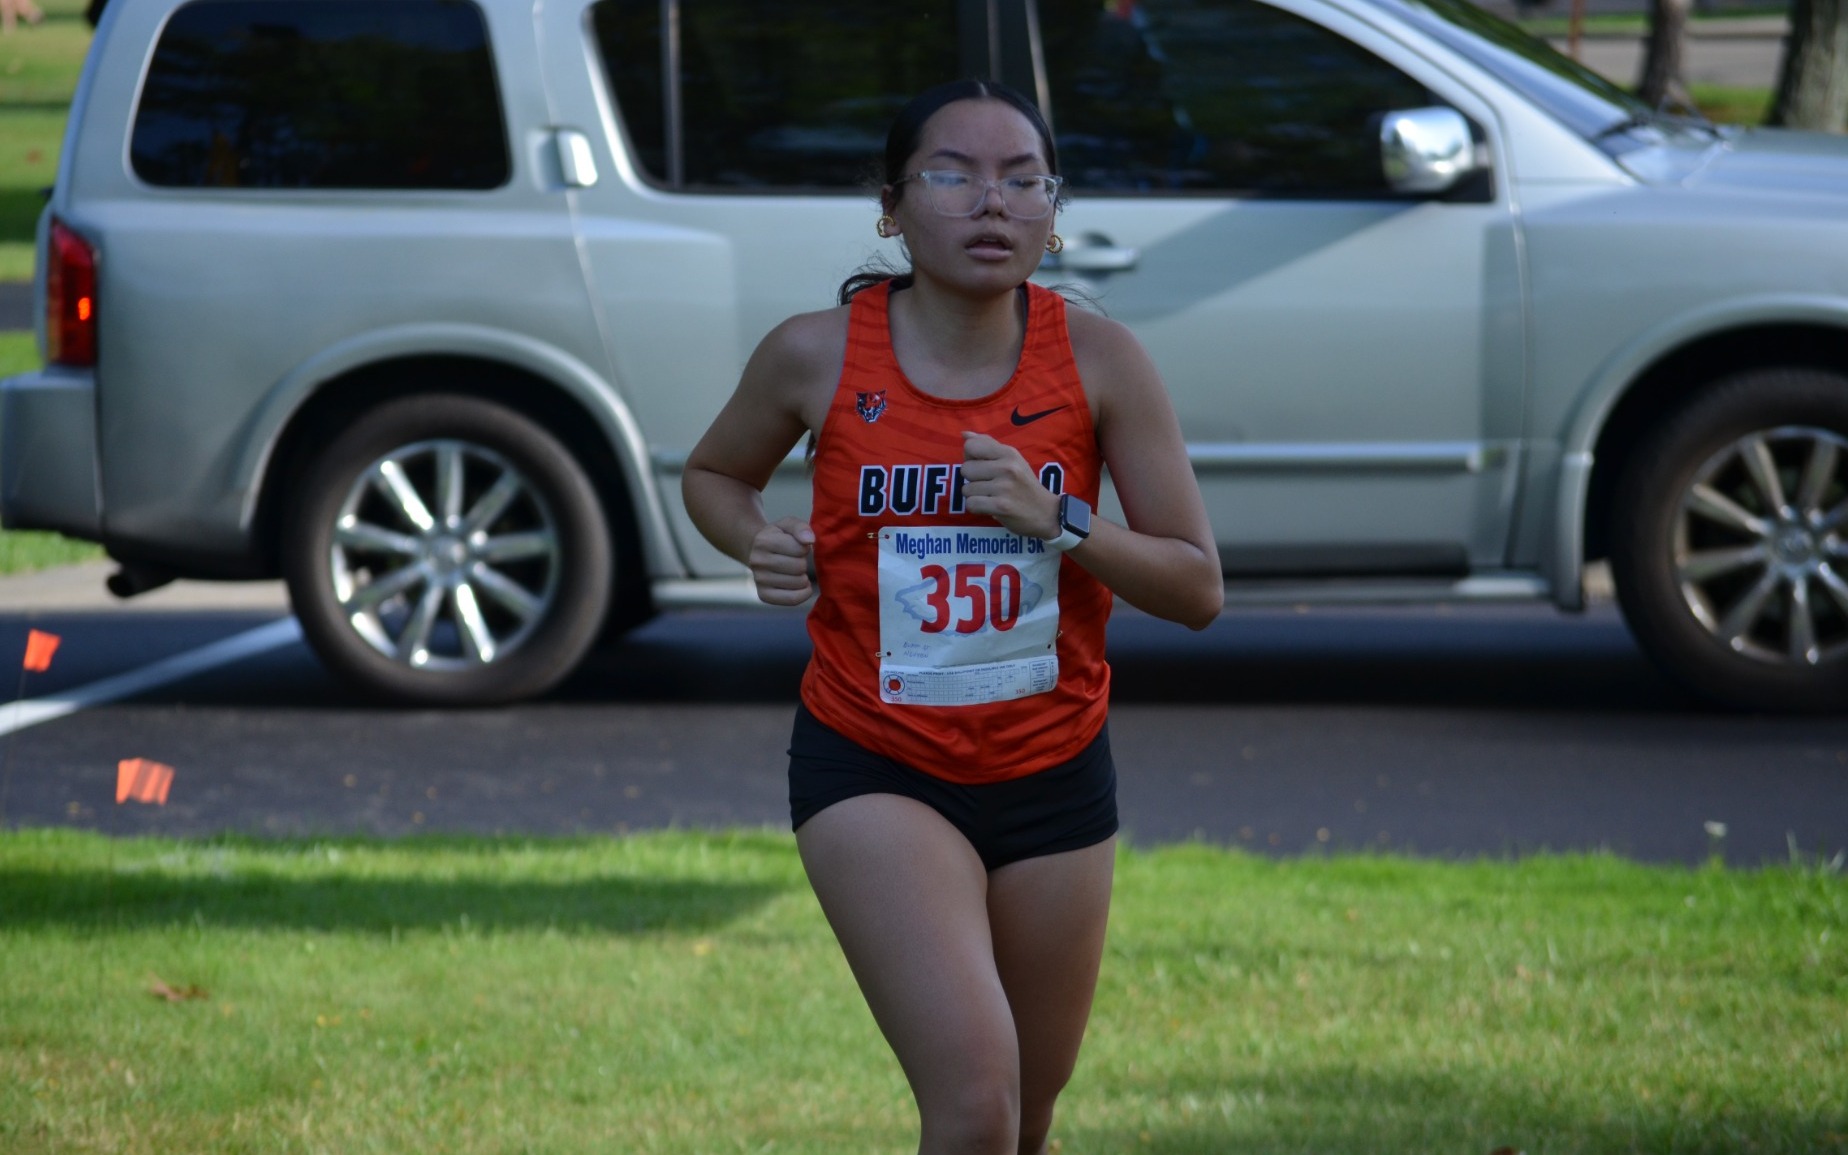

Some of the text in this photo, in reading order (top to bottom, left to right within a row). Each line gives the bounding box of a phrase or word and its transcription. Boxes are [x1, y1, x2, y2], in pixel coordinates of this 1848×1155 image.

[896, 533, 951, 560] Meghan
[956, 533, 1023, 554] Memorial
[920, 564, 1021, 634] 350
